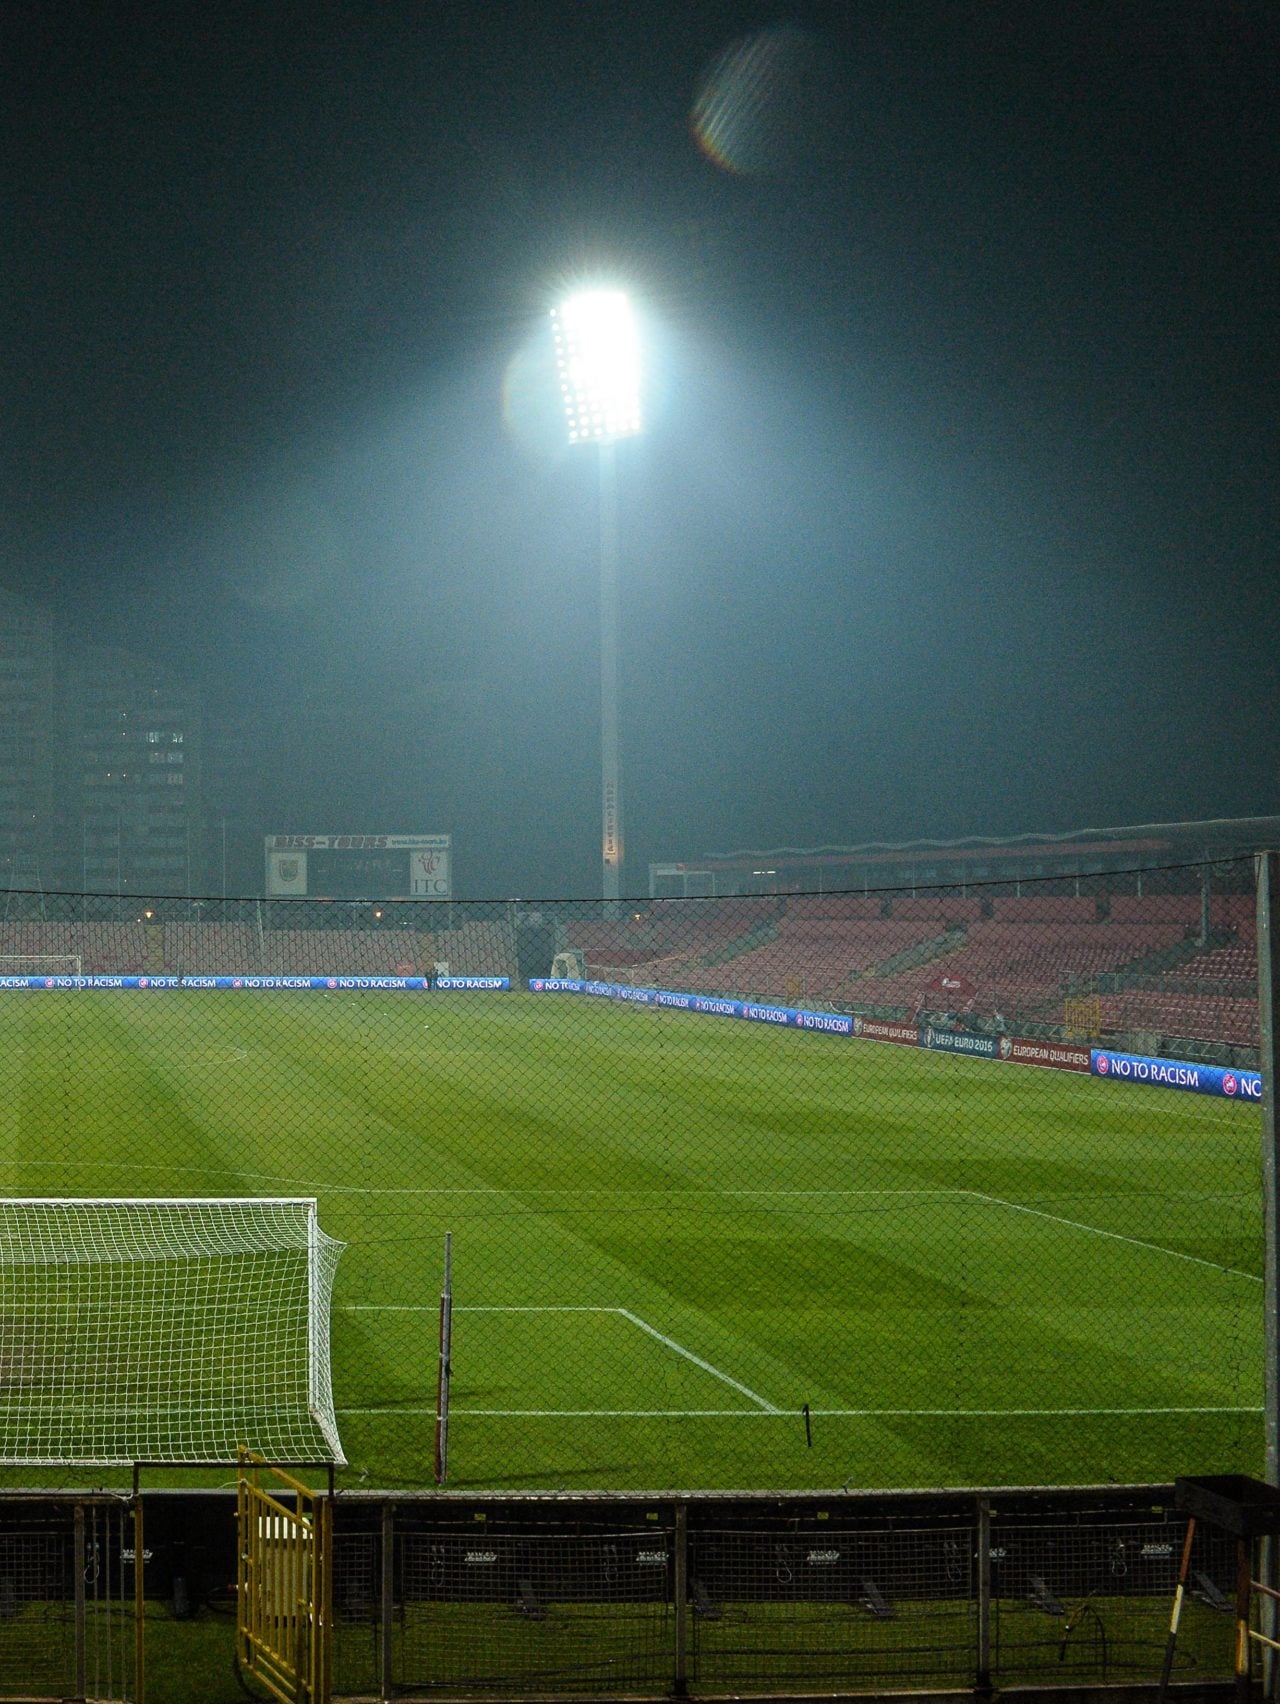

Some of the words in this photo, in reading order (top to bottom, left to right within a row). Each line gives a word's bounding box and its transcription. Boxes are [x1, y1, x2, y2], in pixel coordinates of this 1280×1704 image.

[274, 836, 389, 848] BISS-TOURS
[414, 879, 448, 894] ITC
[57, 979, 71, 987] NO
[73, 979, 86, 987] TO
[87, 979, 122, 987] RACISM
[151, 979, 165, 987] NO
[166, 979, 179, 987] TO
[180, 979, 216, 987] RACISM
[245, 980, 260, 988] NO
[262, 980, 274, 988] TO
[276, 980, 311, 988] RACISM
[339, 980, 354, 988] NO
[356, 980, 369, 988] TO
[370, 980, 406, 988] RACISM
[437, 980, 451, 989] NO
[451, 980, 464, 989] TO
[466, 980, 502, 988] RACISM
[545, 982, 560, 990] NO
[701, 1001, 708, 1010] NO
[708, 1002, 715, 1012] TO
[715, 1002, 735, 1014] RACISM
[749, 1007, 759, 1018] NO
[758, 1008, 766, 1020] TO
[766, 1009, 787, 1023] RACISM
[804, 1015, 814, 1028] NO
[814, 1017, 823, 1029] TO
[824, 1018, 849, 1032] RACISM
[863, 1023, 888, 1036] EUROPEAN
[889, 1027, 918, 1040] QUALIFIERS
[935, 1033, 953, 1045] UEFA
[954, 1036, 973, 1049] EURO
[974, 1039, 993, 1052] 2016
[1013, 1045, 1048, 1059] EUROPEAN
[1049, 1050, 1089, 1065] QUALIFIERS
[1111, 1060, 1131, 1076] NO
[1132, 1062, 1148, 1078] TO
[1151, 1065, 1199, 1087] RACISM
